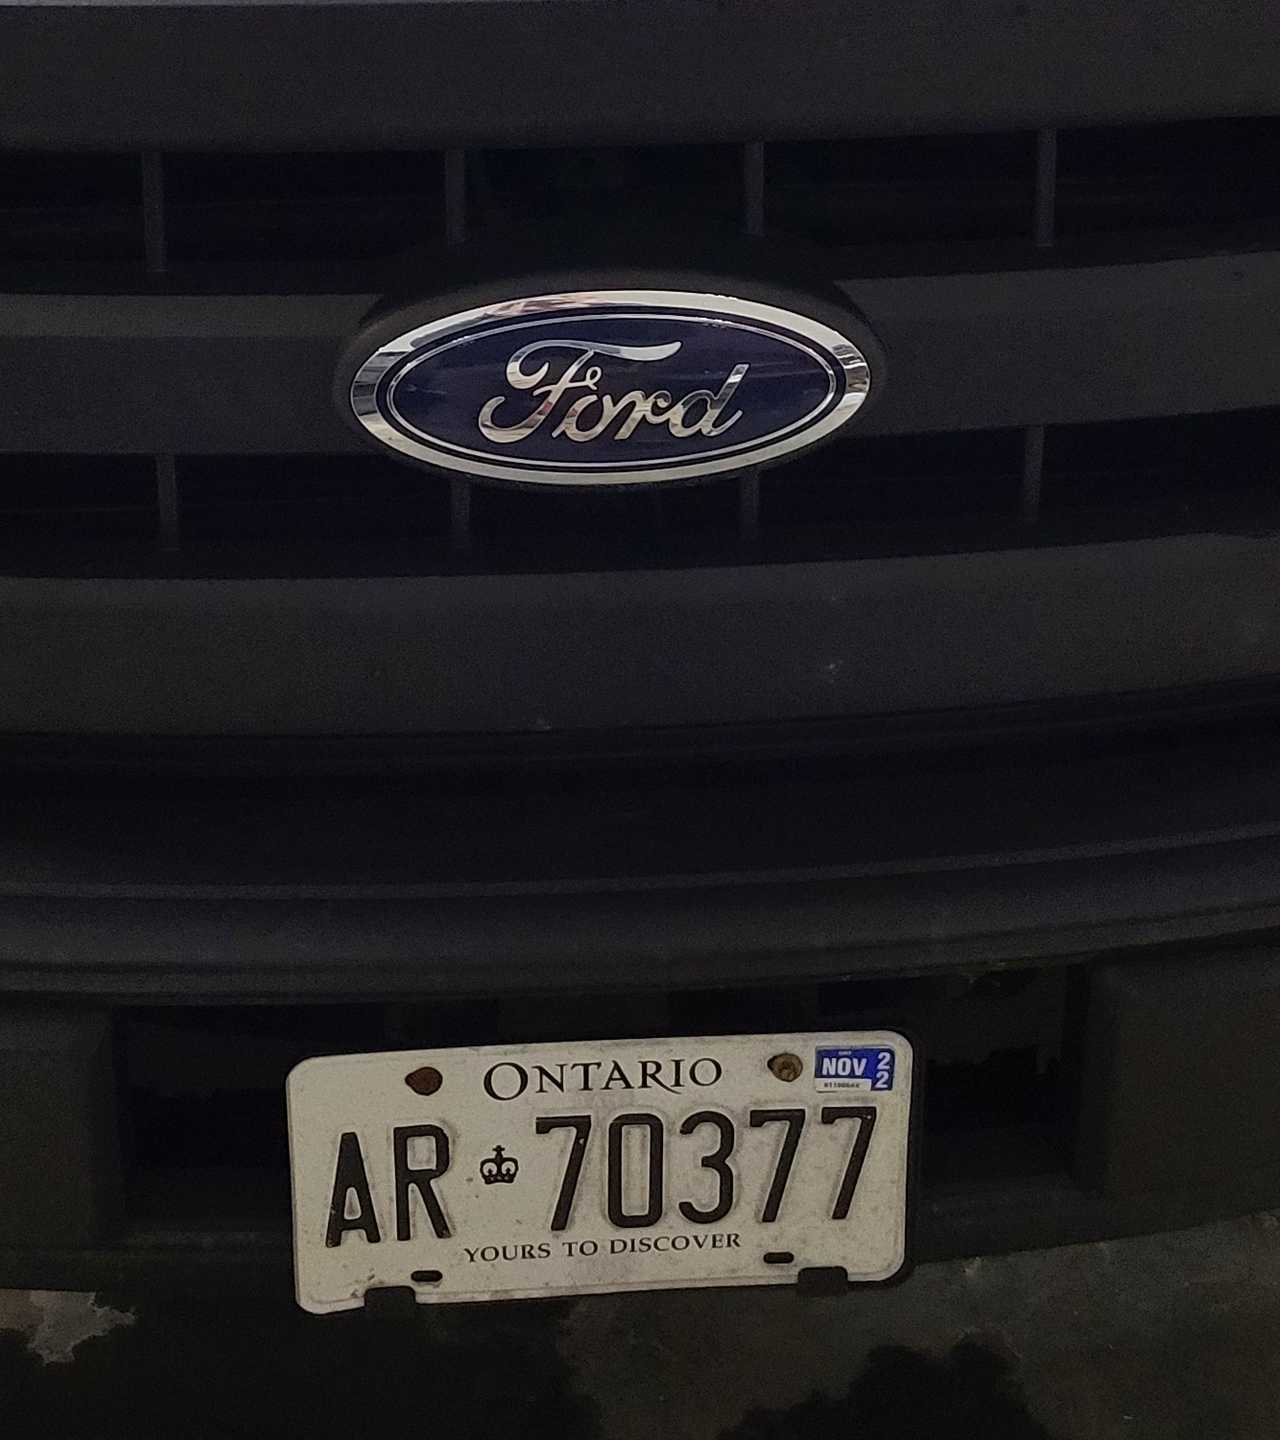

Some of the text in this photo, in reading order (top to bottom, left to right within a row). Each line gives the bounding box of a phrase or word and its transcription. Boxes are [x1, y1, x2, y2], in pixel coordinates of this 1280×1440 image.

[478, 339, 750, 444] Ford
[482, 1057, 723, 1101] ONTARIO
[822, 1058, 867, 1076] NOV
[324, 1105, 878, 1248] AR 70377
[464, 1232, 741, 1264] YOURS TO DISCOVER
